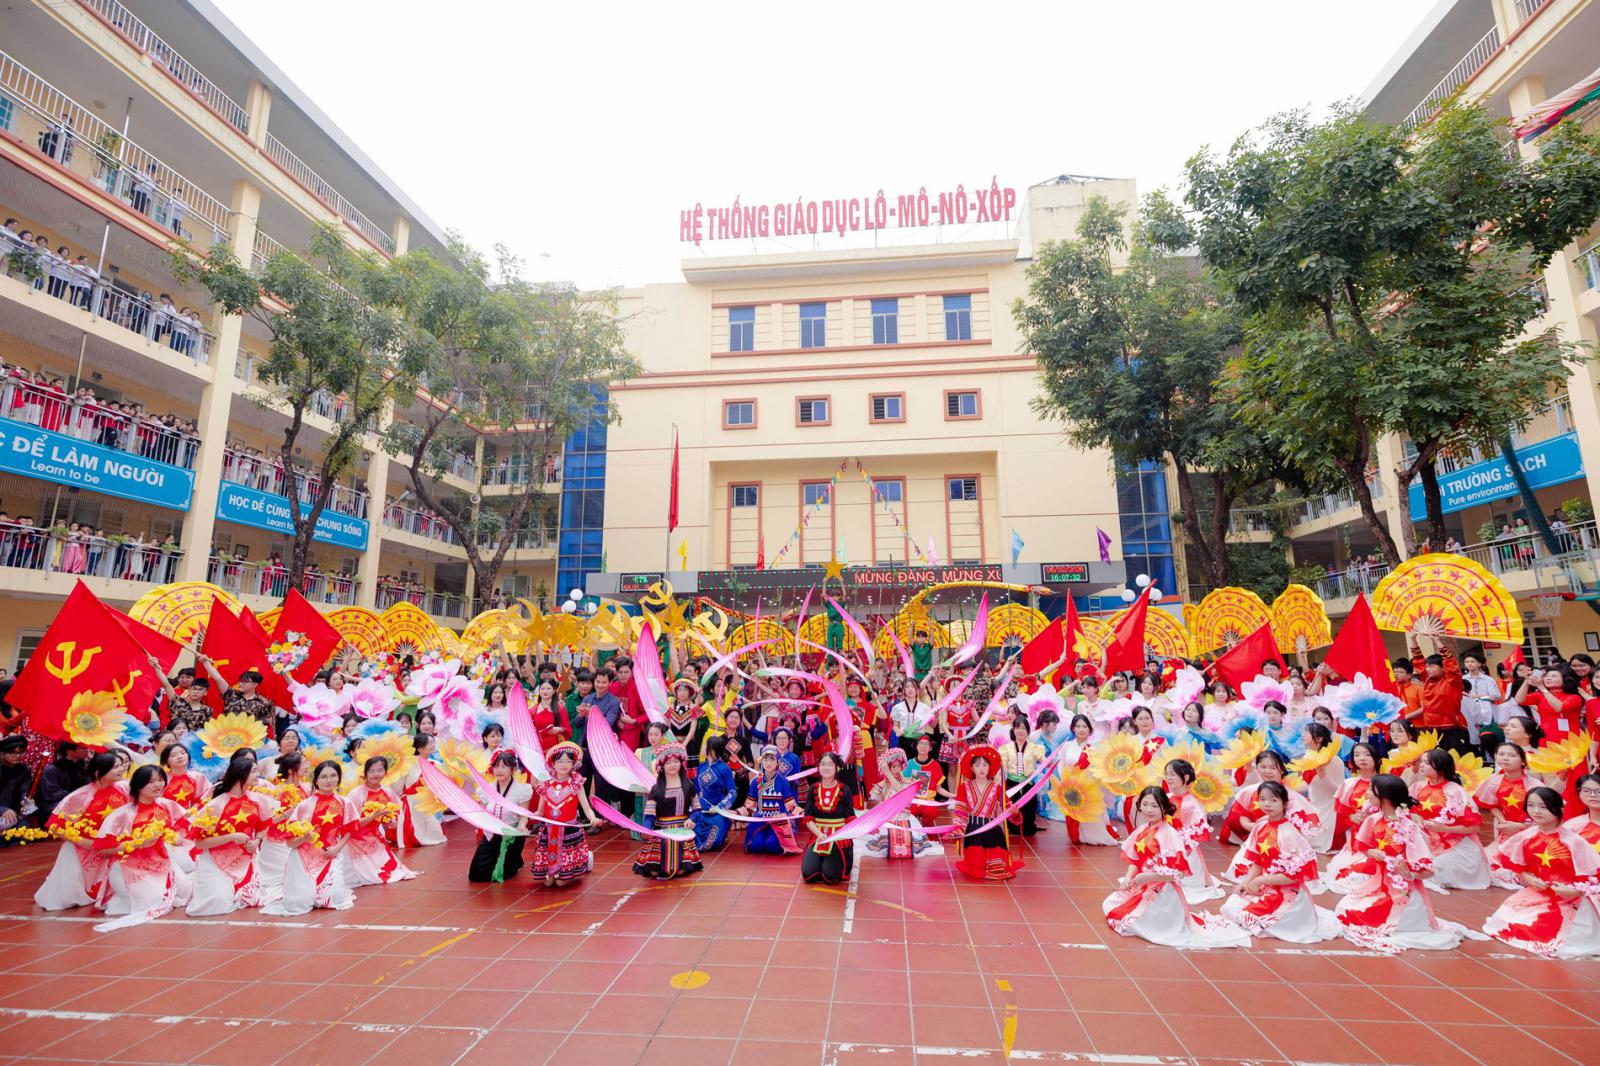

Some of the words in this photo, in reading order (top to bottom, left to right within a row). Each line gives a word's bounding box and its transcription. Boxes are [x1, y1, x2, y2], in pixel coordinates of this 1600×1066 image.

[680, 202, 703, 246] HỆ
[707, 194, 769, 240] THỐNG
[774, 196, 817, 236] GIÁO
[822, 198, 860, 237] DỤC
[12, 434, 48, 458] ĐỂ
[51, 446, 99, 471] LÀM
[104, 460, 165, 488] NGƯỜI
[31, 459, 66, 477] Learn
[69, 468, 82, 480] to
[84, 471, 100, 484] be
[1448, 468, 1502, 494] TRƯỜNG
[1448, 495, 1465, 507] Pure
[229, 494, 250, 510] HỌC
[316, 518, 342, 532] CHUNG
[342, 521, 362, 537] SỐNG
[267, 517, 286, 528] Learn
[286, 521, 294, 530] to
[313, 528, 333, 540] gether
[855, 569, 894, 584] MỪNG
[943, 566, 984, 583] MỪNG
